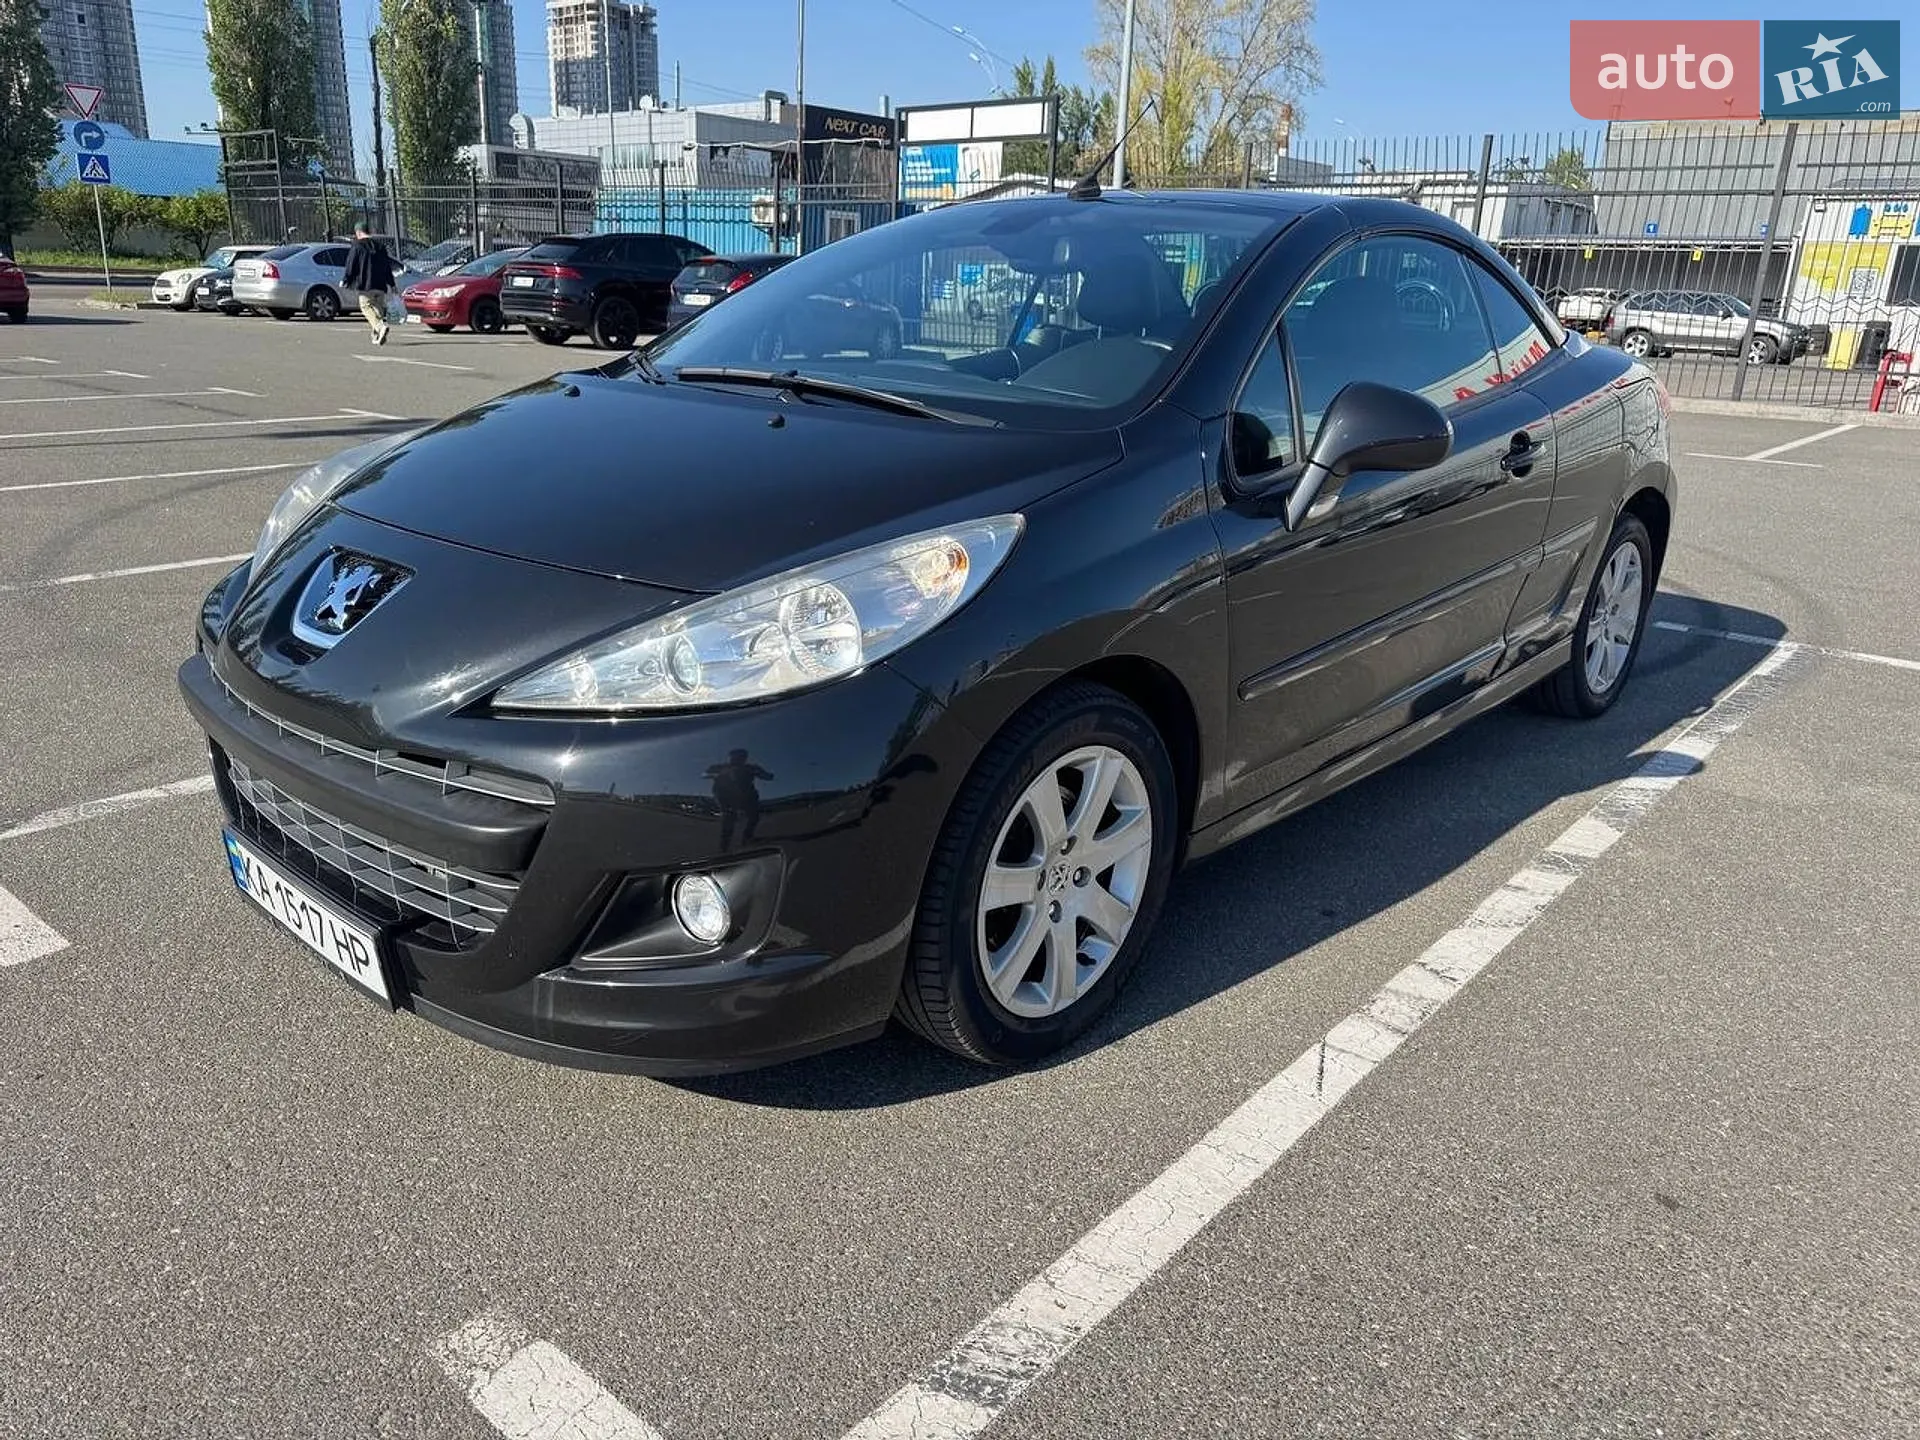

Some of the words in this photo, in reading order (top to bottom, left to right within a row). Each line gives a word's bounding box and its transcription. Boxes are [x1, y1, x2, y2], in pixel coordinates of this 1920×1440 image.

[859, 122, 887, 138] CAR
[244, 857, 276, 910] KA
[275, 881, 324, 948] 1517
[329, 919, 370, 976] HP
